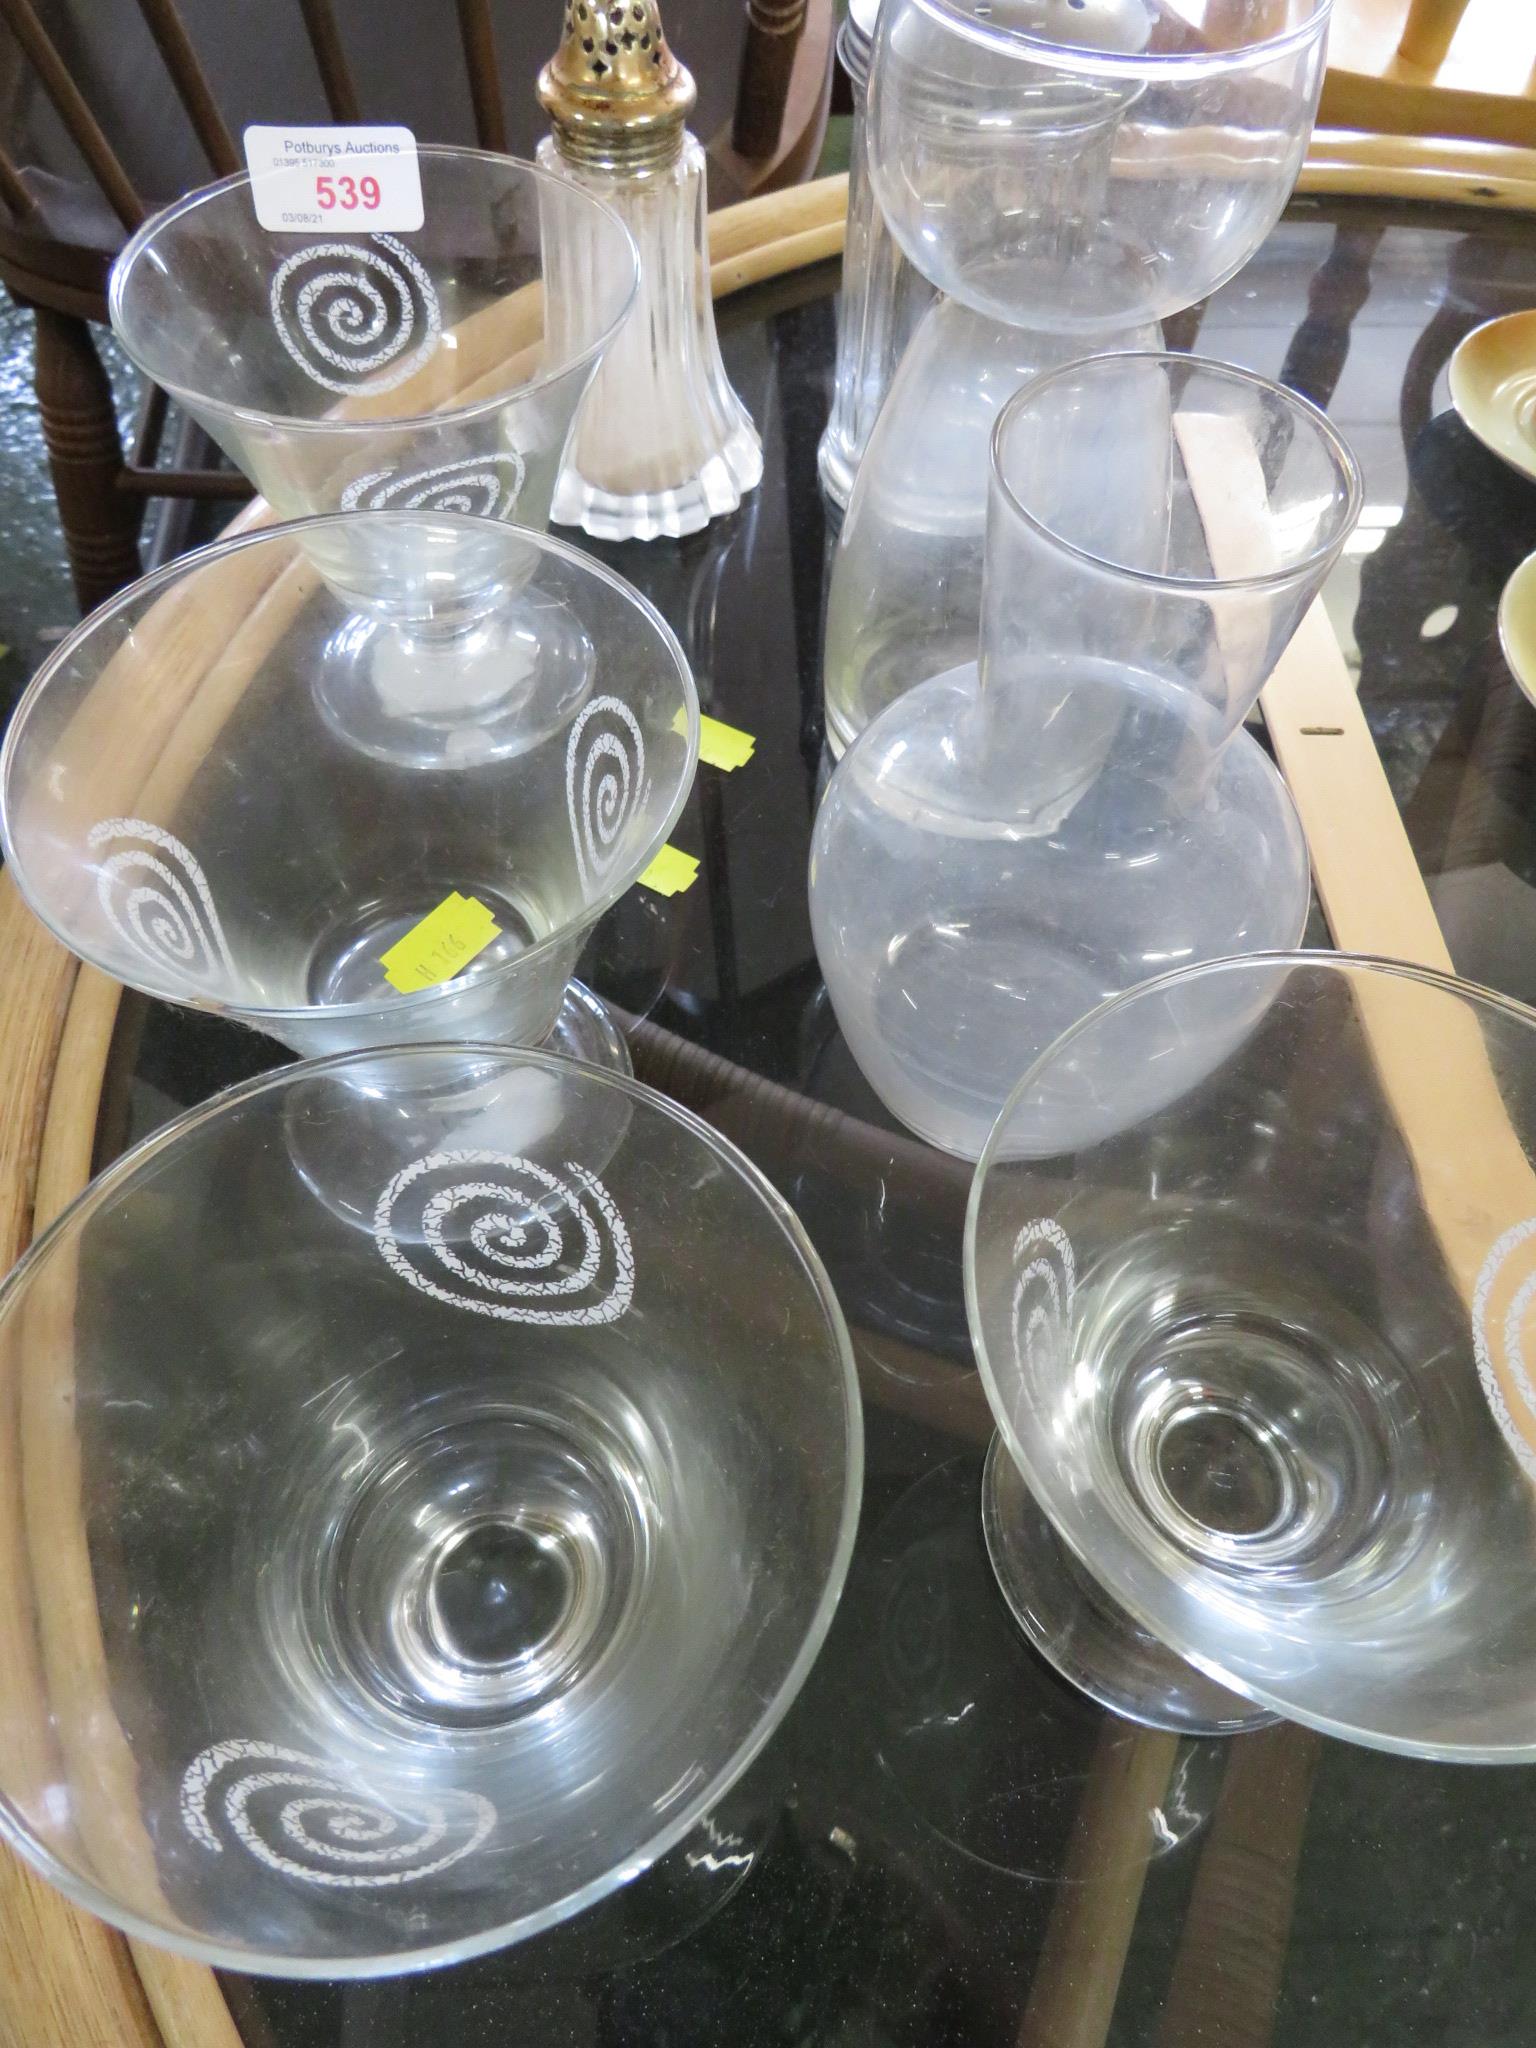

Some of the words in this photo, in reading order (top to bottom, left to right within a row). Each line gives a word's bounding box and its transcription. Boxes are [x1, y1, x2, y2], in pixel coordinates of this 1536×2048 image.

[284, 140, 341, 156] Potburys
[345, 141, 400, 154] Auctions
[316, 176, 381, 210] 539
[282, 212, 323, 224] 03/08/21
